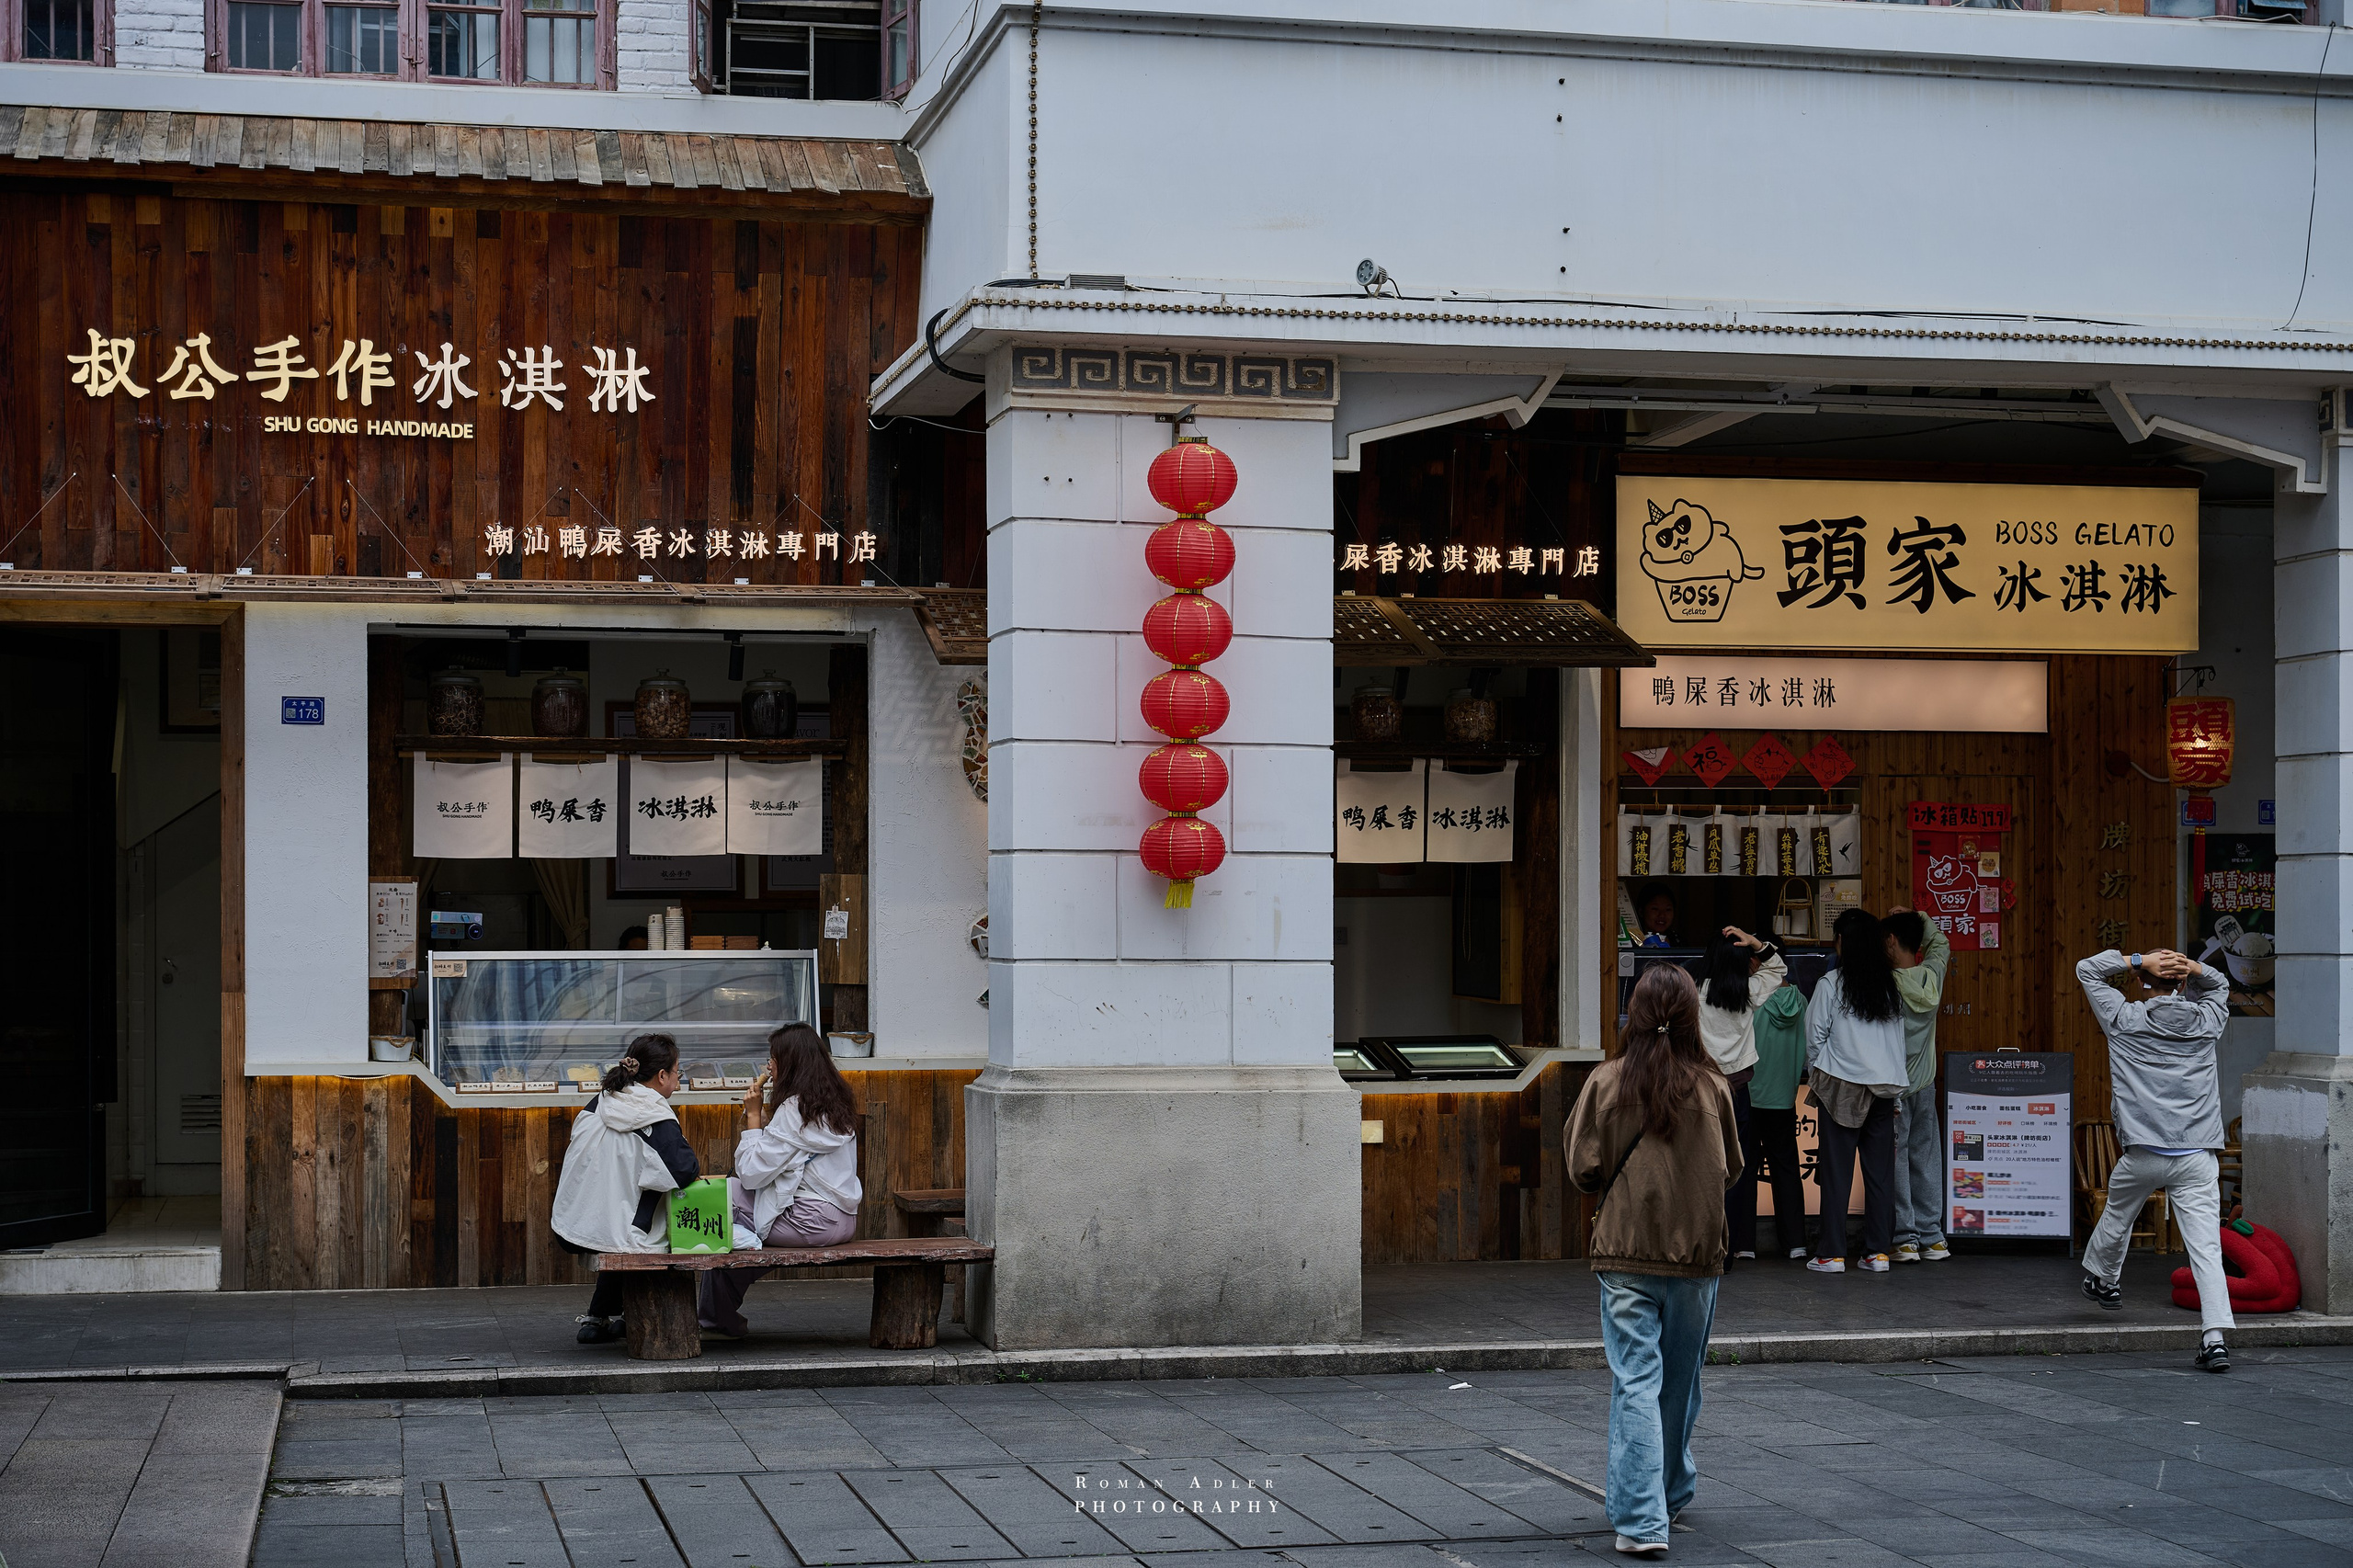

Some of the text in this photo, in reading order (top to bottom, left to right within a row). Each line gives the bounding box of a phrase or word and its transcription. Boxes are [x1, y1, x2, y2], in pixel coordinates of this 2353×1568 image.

[67, 328, 656, 414] 叔公手作冰淇淋
[264, 416, 473, 439] SHU GONG HANDMADE
[484, 525, 877, 564] 潮汕鴨屎香冰淇淋專門店
[1995, 519, 2175, 548] BOSS GELATO
[1339, 541, 1600, 578] 屎香冰淇淋專門店
[1776, 515, 1976, 615] 頭家
[1669, 585, 1720, 607] BOSS
[1993, 559, 2177, 615] 冰淇淋
[1681, 608, 1707, 617] Gelato
[1653, 676, 1837, 709] 鴨屎香冰淇淋
[298, 708, 319, 719] 178
[2169, 701, 2232, 784] 頭家
[1692, 746, 1716, 774] 福
[437, 801, 488, 813] 叔公手作
[529, 797, 608, 824] 鸭屎香
[638, 795, 718, 822] 冰淇淋
[749, 799, 799, 812] 叔公手作
[1342, 804, 1418, 832] 鸭屎香
[1914, 806, 2005, 827] 冰箱贴 19.9
[1432, 805, 1511, 834] 冰淇淋
[2203, 870, 2275, 892] 屎香冰淇
[1940, 893, 1966, 905] BOSS
[2211, 891, 2272, 910] 免费试吃
[1985, 1060, 2040, 1069] 大众点评榜单
[676, 1206, 724, 1240] 潮州
